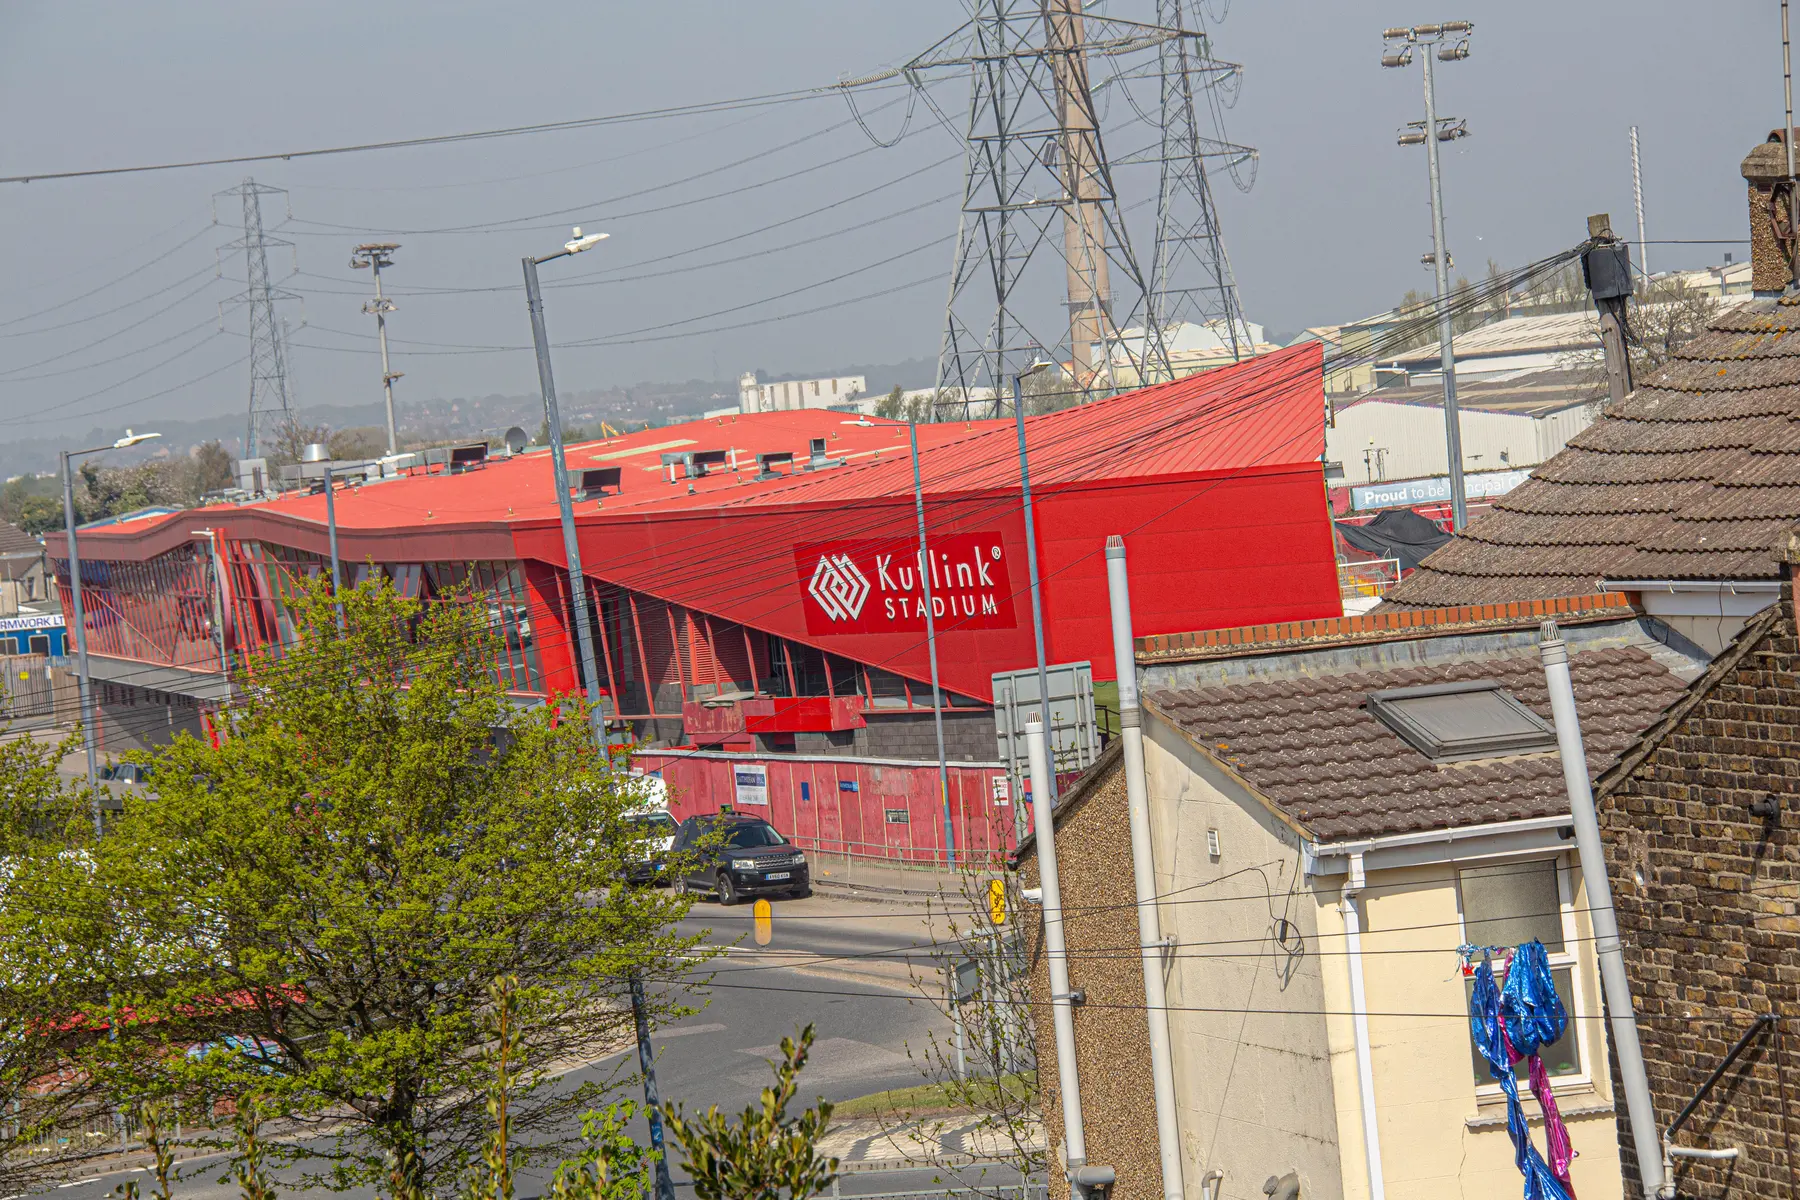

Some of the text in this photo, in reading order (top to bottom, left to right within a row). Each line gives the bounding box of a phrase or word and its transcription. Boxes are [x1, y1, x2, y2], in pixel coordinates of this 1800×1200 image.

[1364, 488, 1407, 504] Proud
[1412, 487, 1424, 499] to
[1428, 480, 1444, 497] be
[1448, 478, 1505, 497] ncipal
[885, 594, 998, 618] STADIUM
